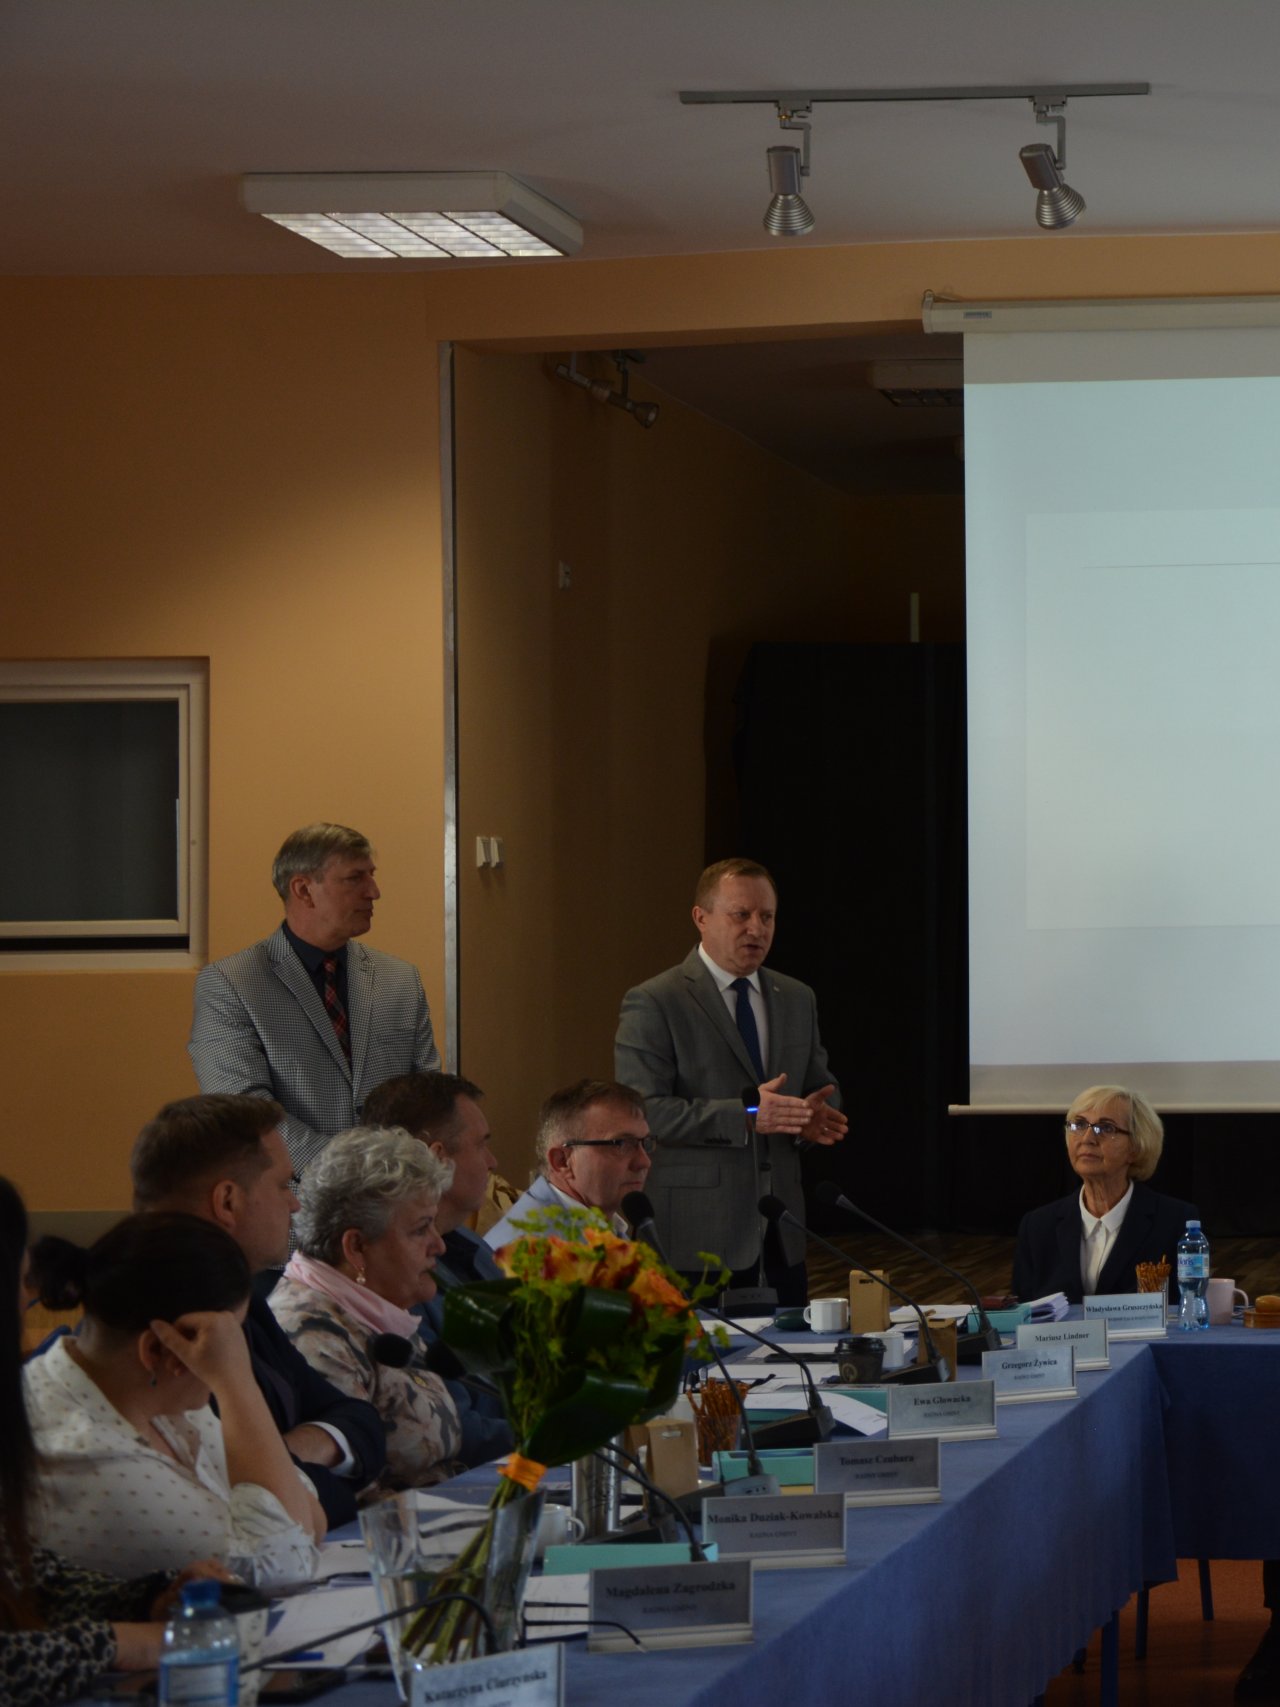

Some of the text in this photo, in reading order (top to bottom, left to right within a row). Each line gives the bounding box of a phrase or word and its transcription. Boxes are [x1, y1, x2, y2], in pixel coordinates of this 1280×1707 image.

[1035, 1332, 1090, 1343] Mariusz Lindner
[708, 1513, 747, 1524] Monika
